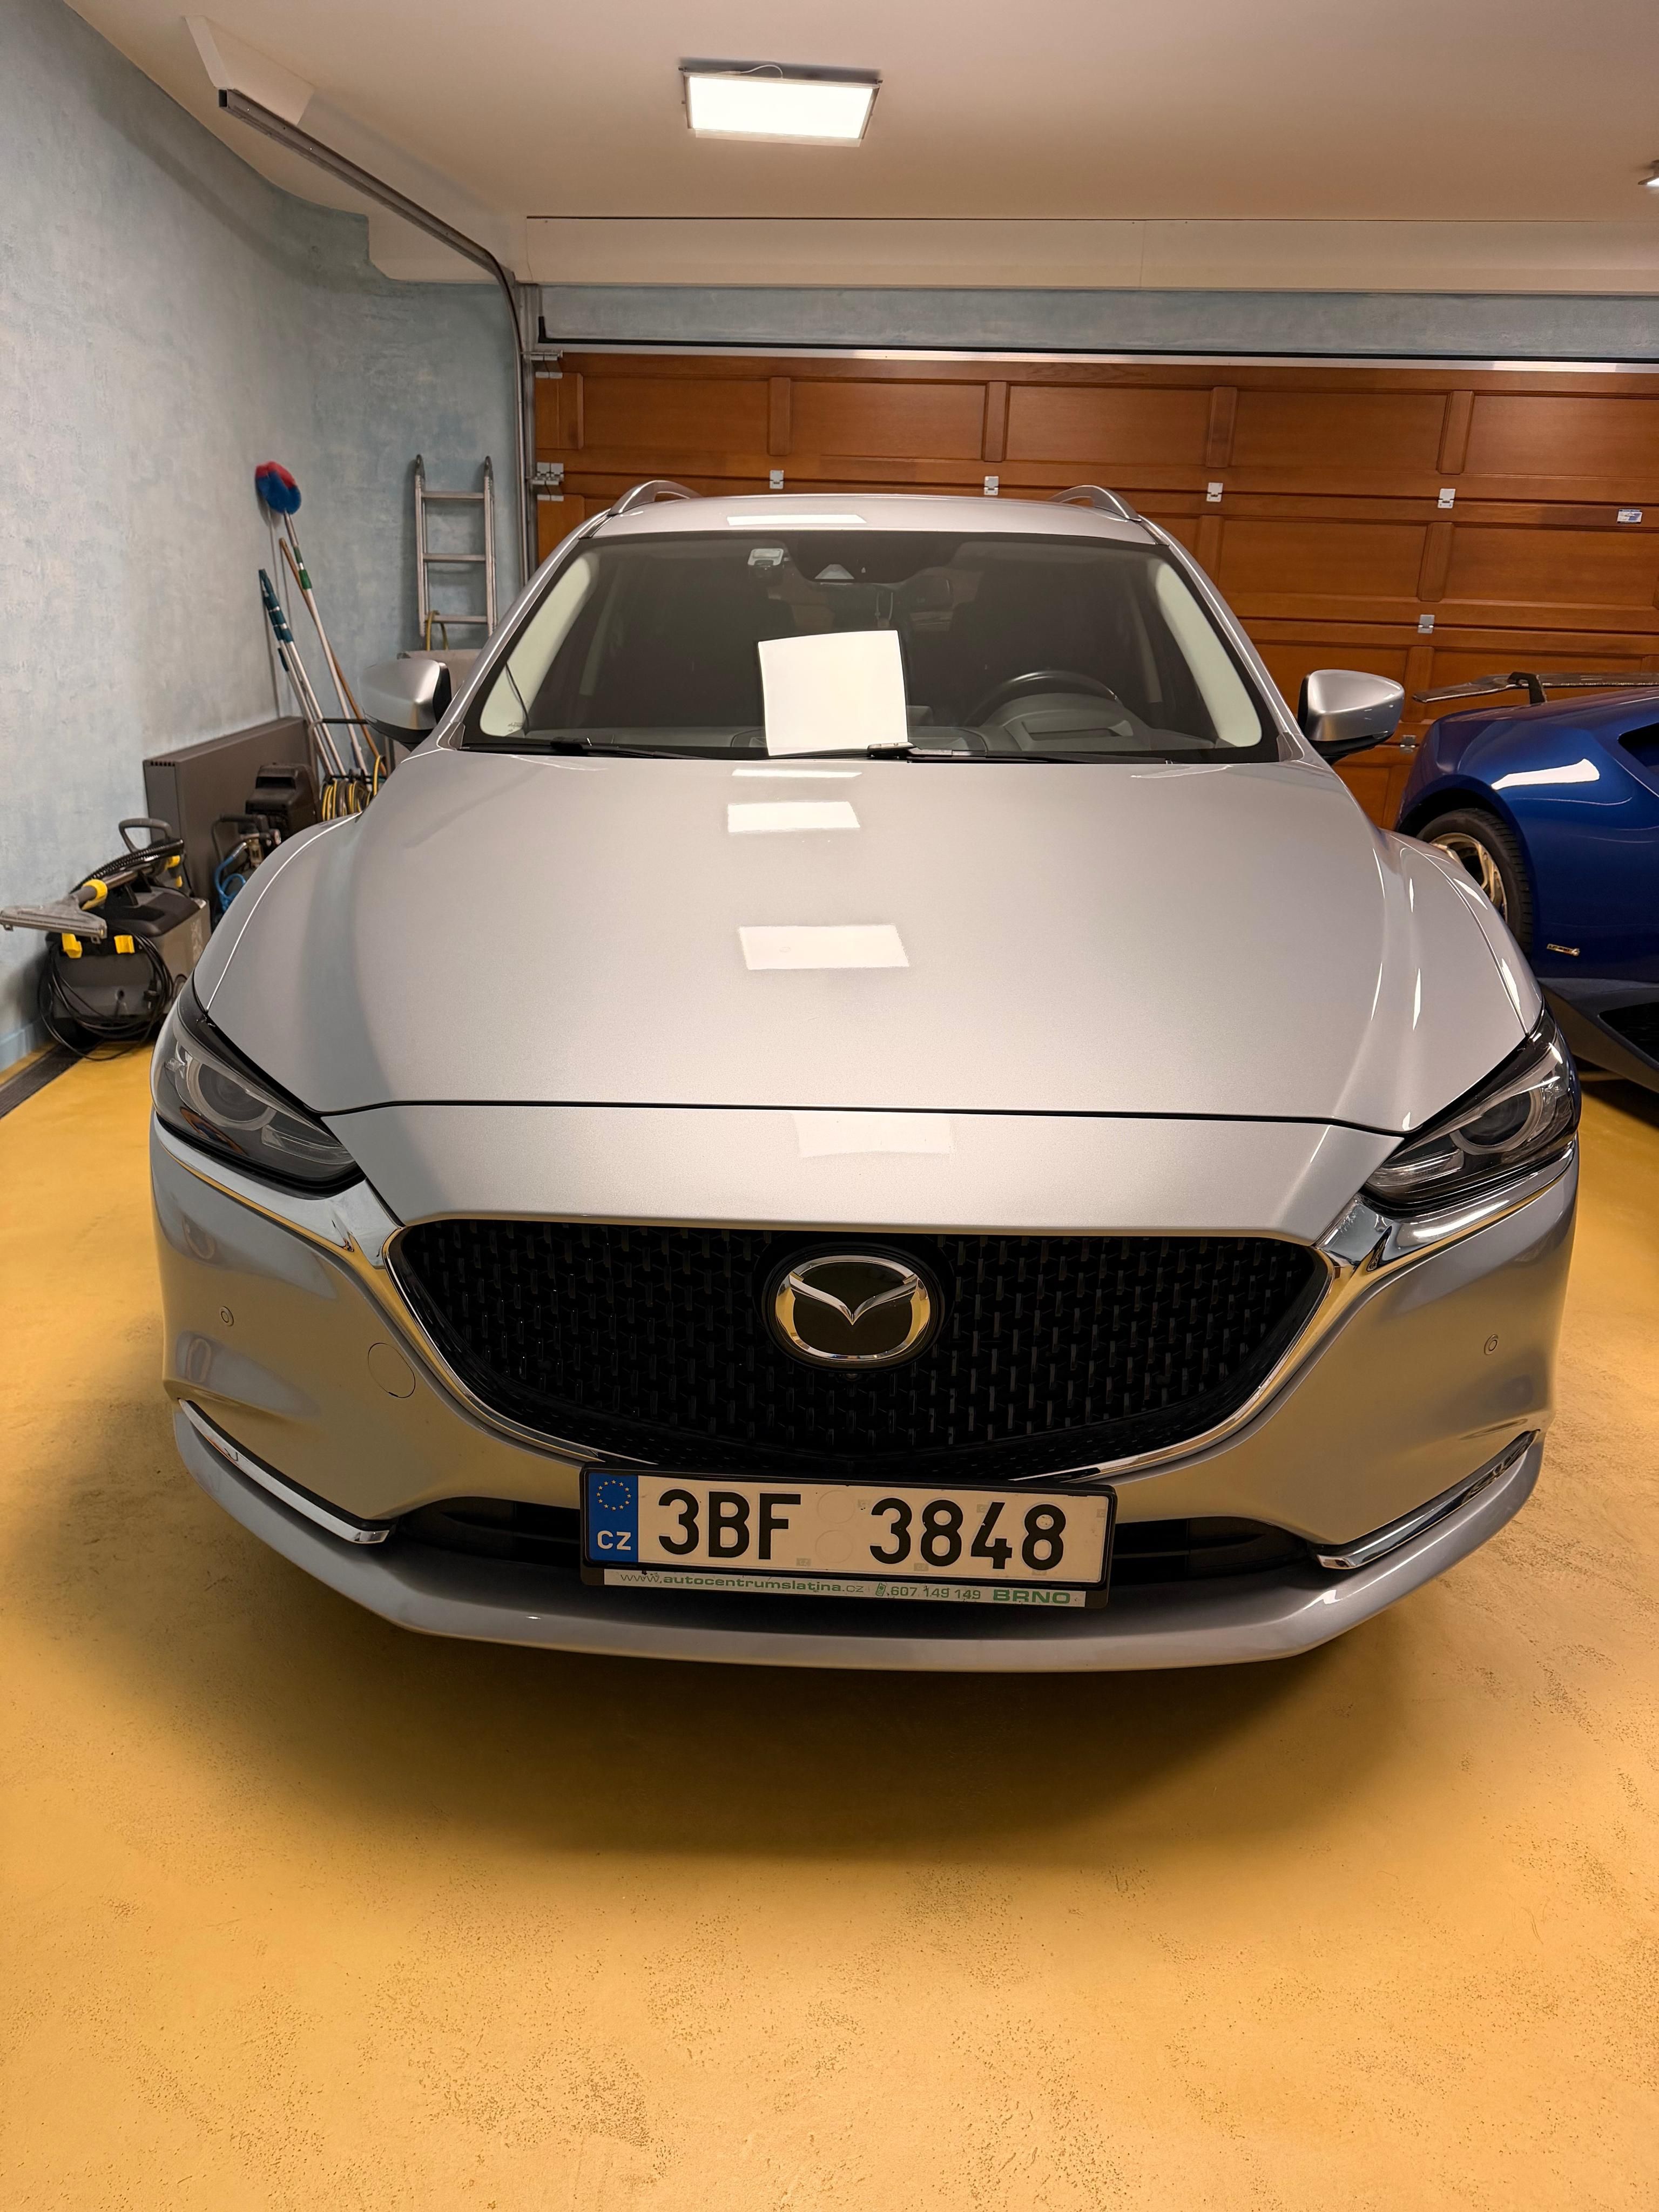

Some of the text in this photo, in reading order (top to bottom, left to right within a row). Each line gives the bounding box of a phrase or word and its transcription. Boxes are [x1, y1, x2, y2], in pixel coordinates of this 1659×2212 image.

[597, 1530, 631, 1550] CZ
[658, 1488, 1066, 1570] 3BF 3848
[621, 1574, 1070, 1604] www.autocentrumslatina.cz 607 149 149 BRNO
